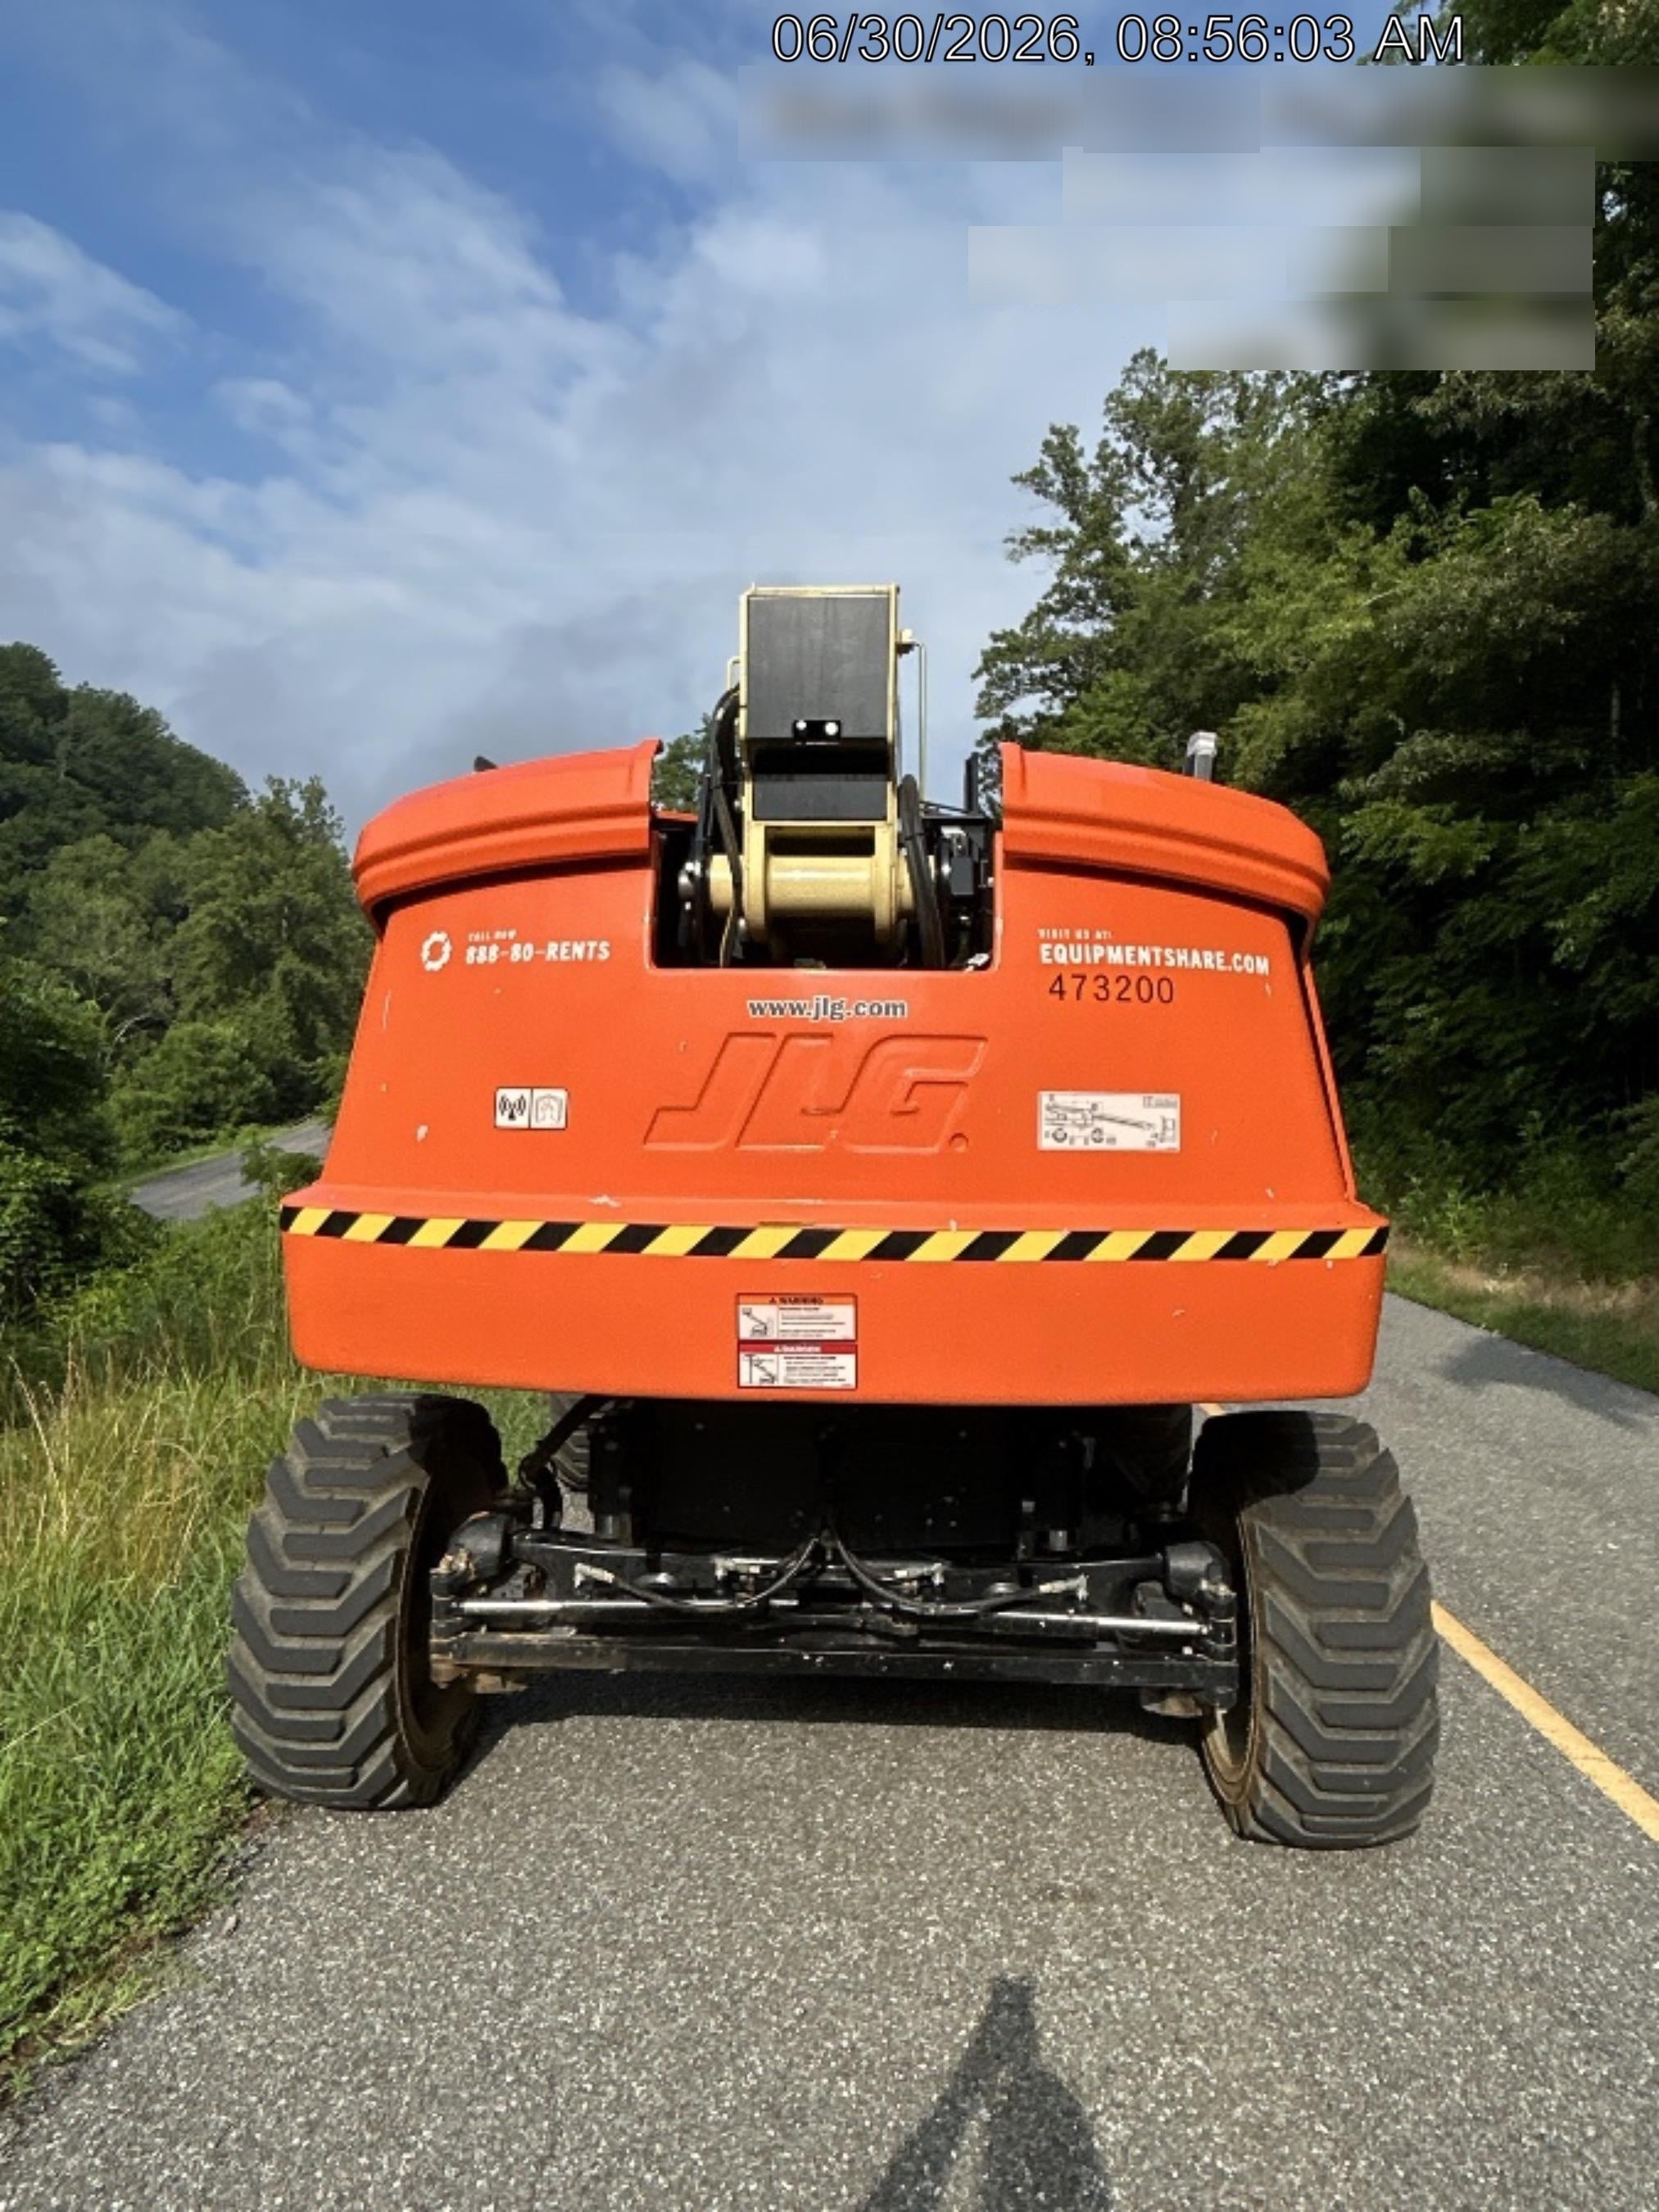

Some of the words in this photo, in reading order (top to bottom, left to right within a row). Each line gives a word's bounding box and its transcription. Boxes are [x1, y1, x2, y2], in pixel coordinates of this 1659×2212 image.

[1040, 943, 1270, 975] EQUIPMENTSHARE.COM
[1049, 972, 1174, 1004] 473200
[747, 996, 909, 1021] www.jlg.com
